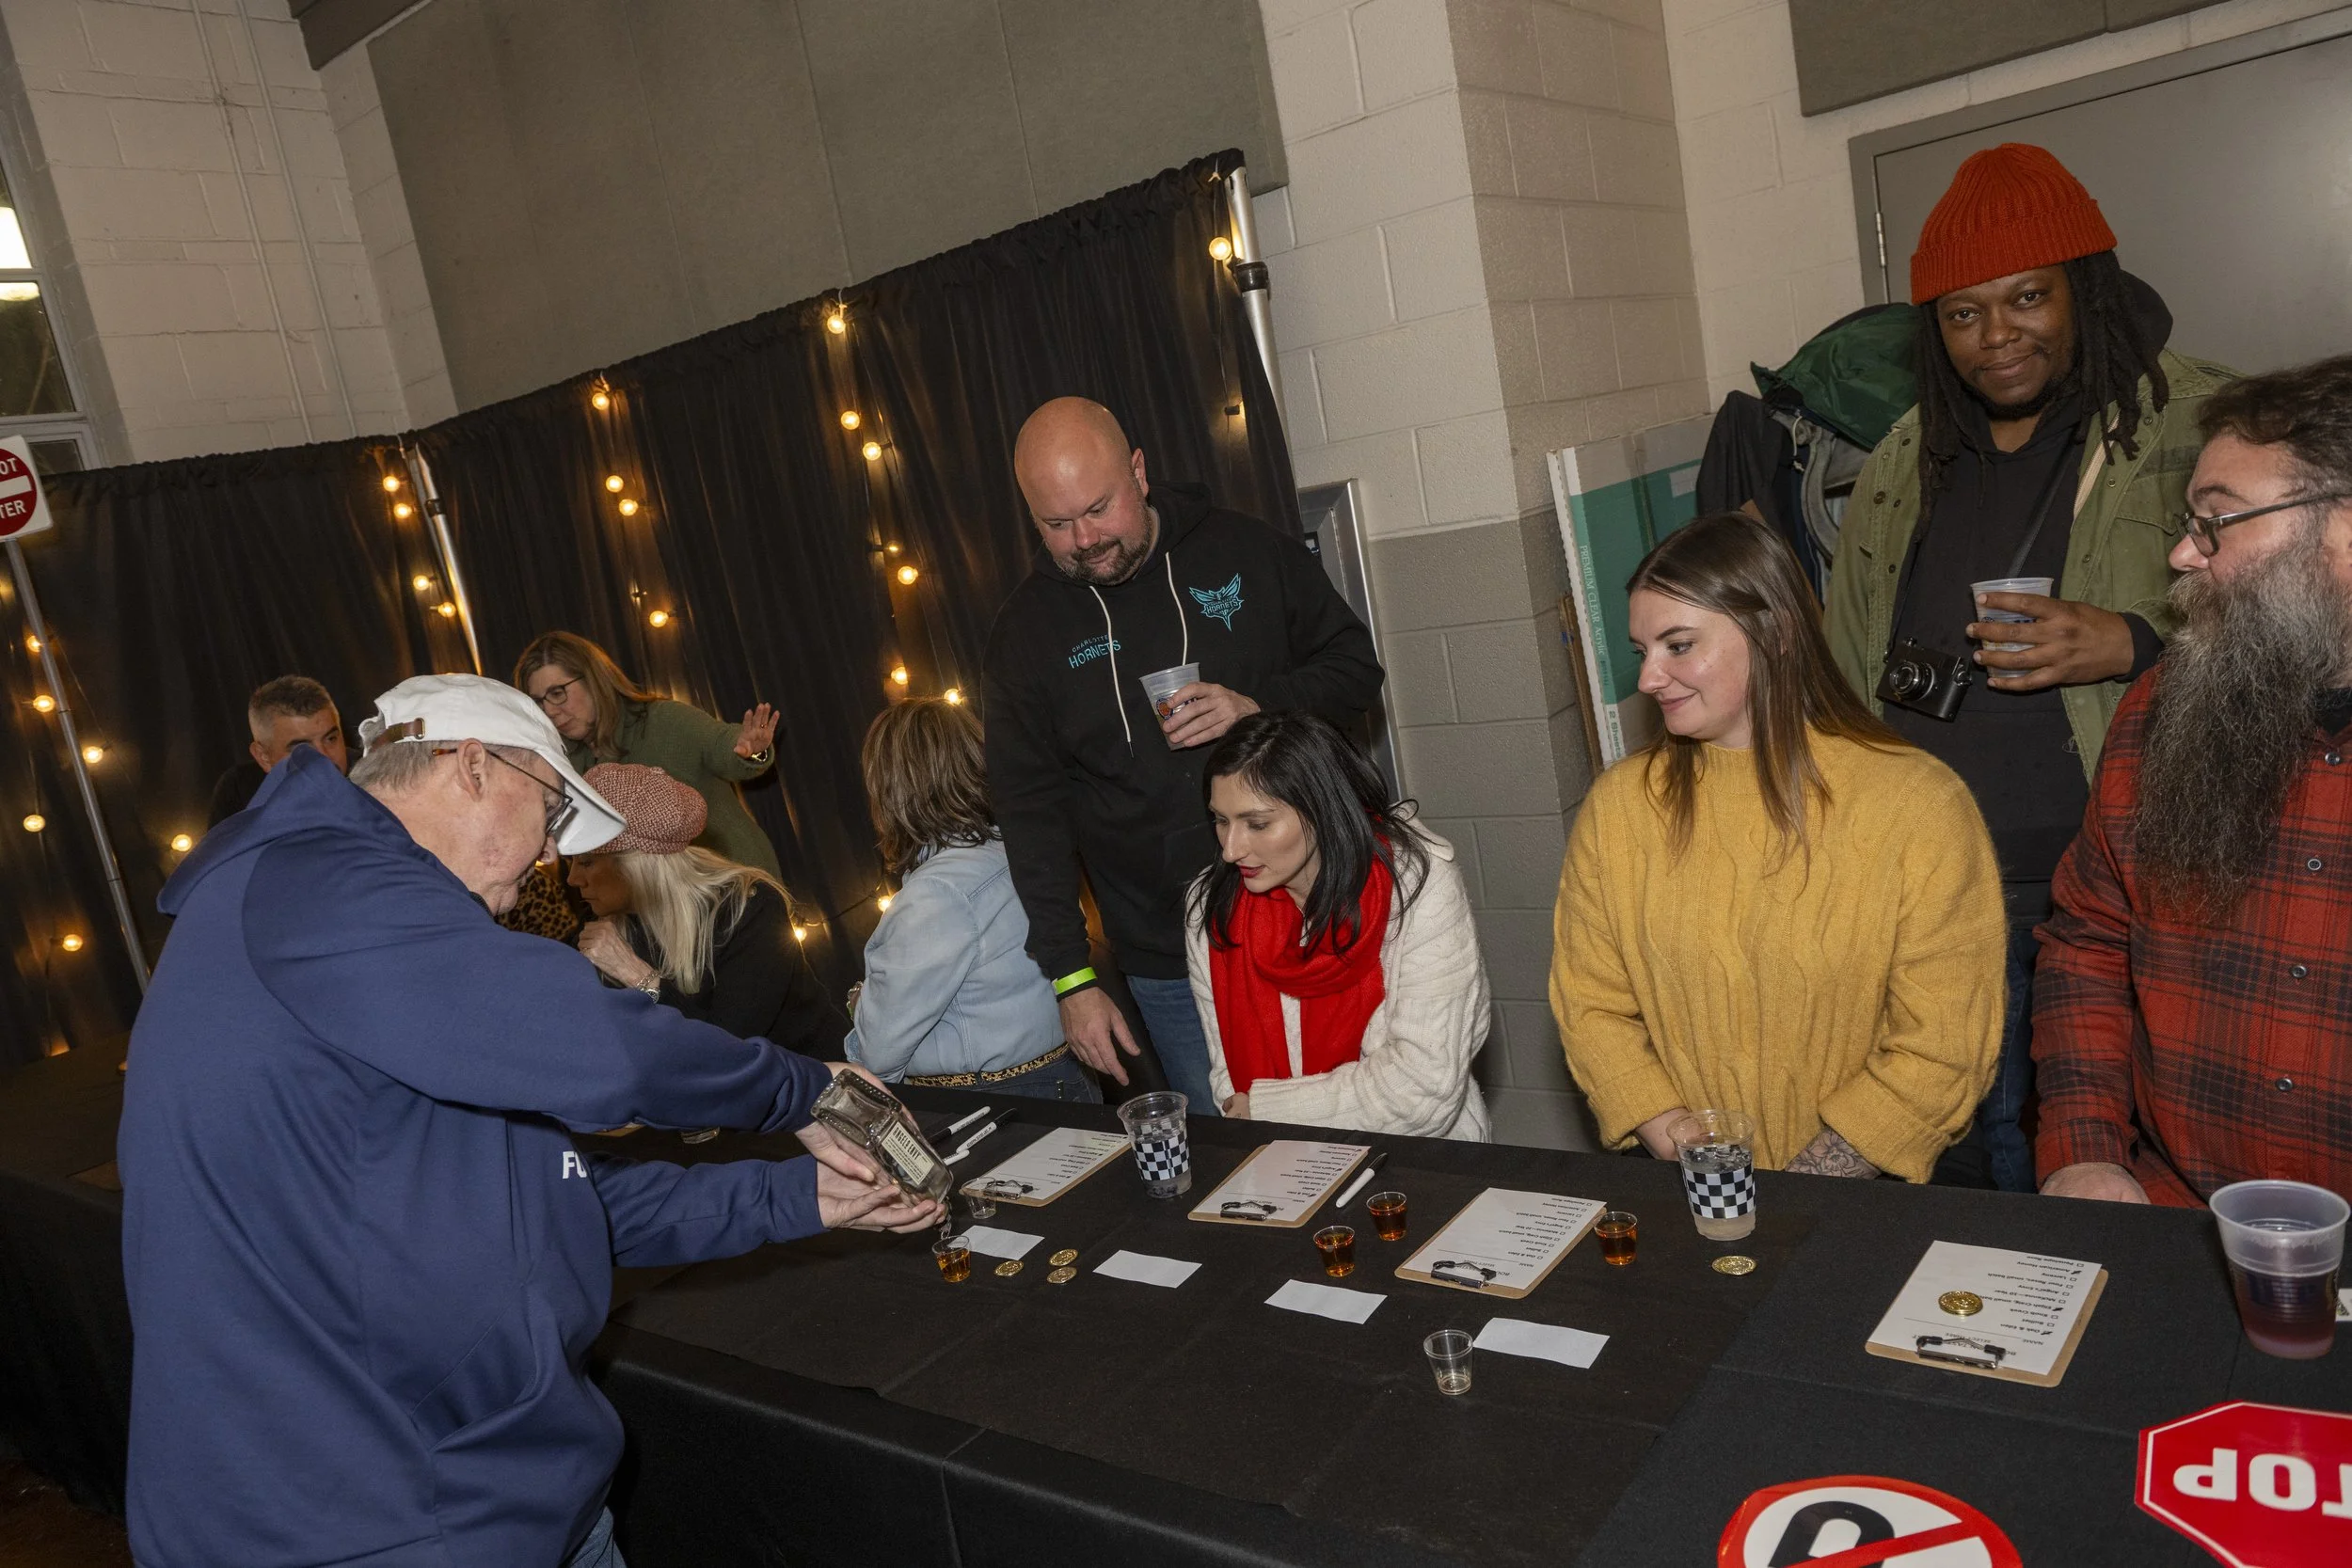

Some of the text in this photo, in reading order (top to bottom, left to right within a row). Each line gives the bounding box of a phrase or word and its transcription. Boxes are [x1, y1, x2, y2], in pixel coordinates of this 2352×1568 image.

[0, 457, 19, 475] OT
[0, 499, 26, 519] TER
[1581, 545, 1593, 589] PREMIUM
[1588, 592, 1599, 623] CLEAR
[1595, 626, 1605, 656] Acrylic
[1069, 640, 1121, 669] HORNETS
[2173, 1448, 2352, 1519] TOP
